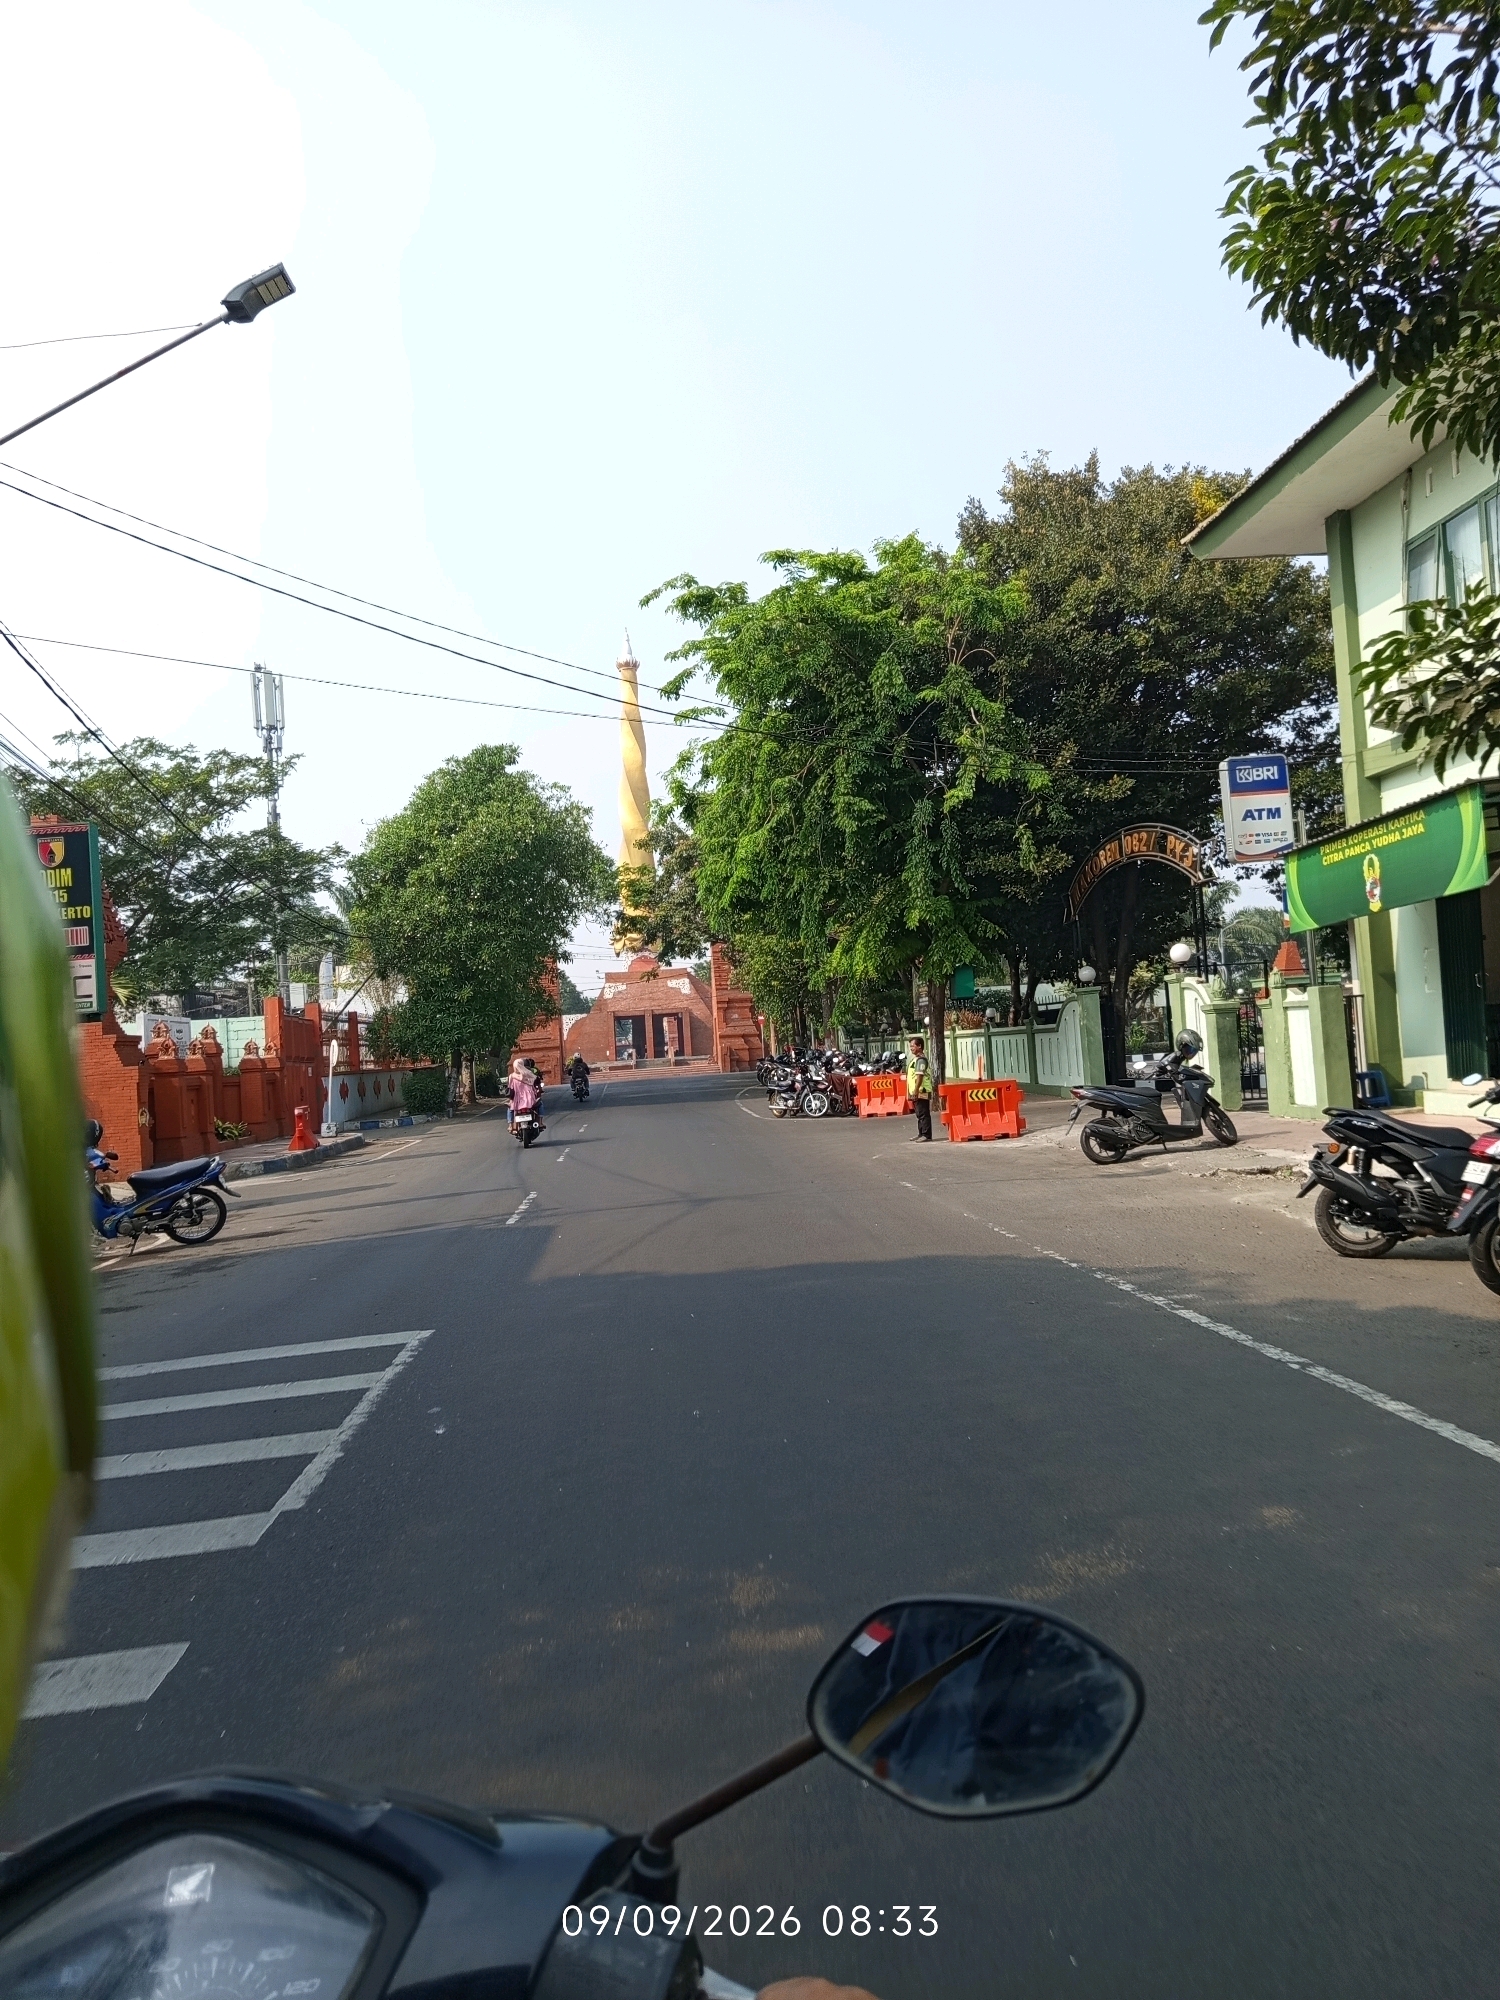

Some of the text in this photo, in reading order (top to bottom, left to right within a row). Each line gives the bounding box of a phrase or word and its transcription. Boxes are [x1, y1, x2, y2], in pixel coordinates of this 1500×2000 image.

[1252, 765, 1279, 781] BRI
[1241, 807, 1282, 821] ATM
[1320, 810, 1426, 855] PRIMER KOPERASI KARTIKA
[1322, 823, 1425, 866] CITRA PANCA YUDHA JAYA
[40, 868, 73, 888] ODIM
